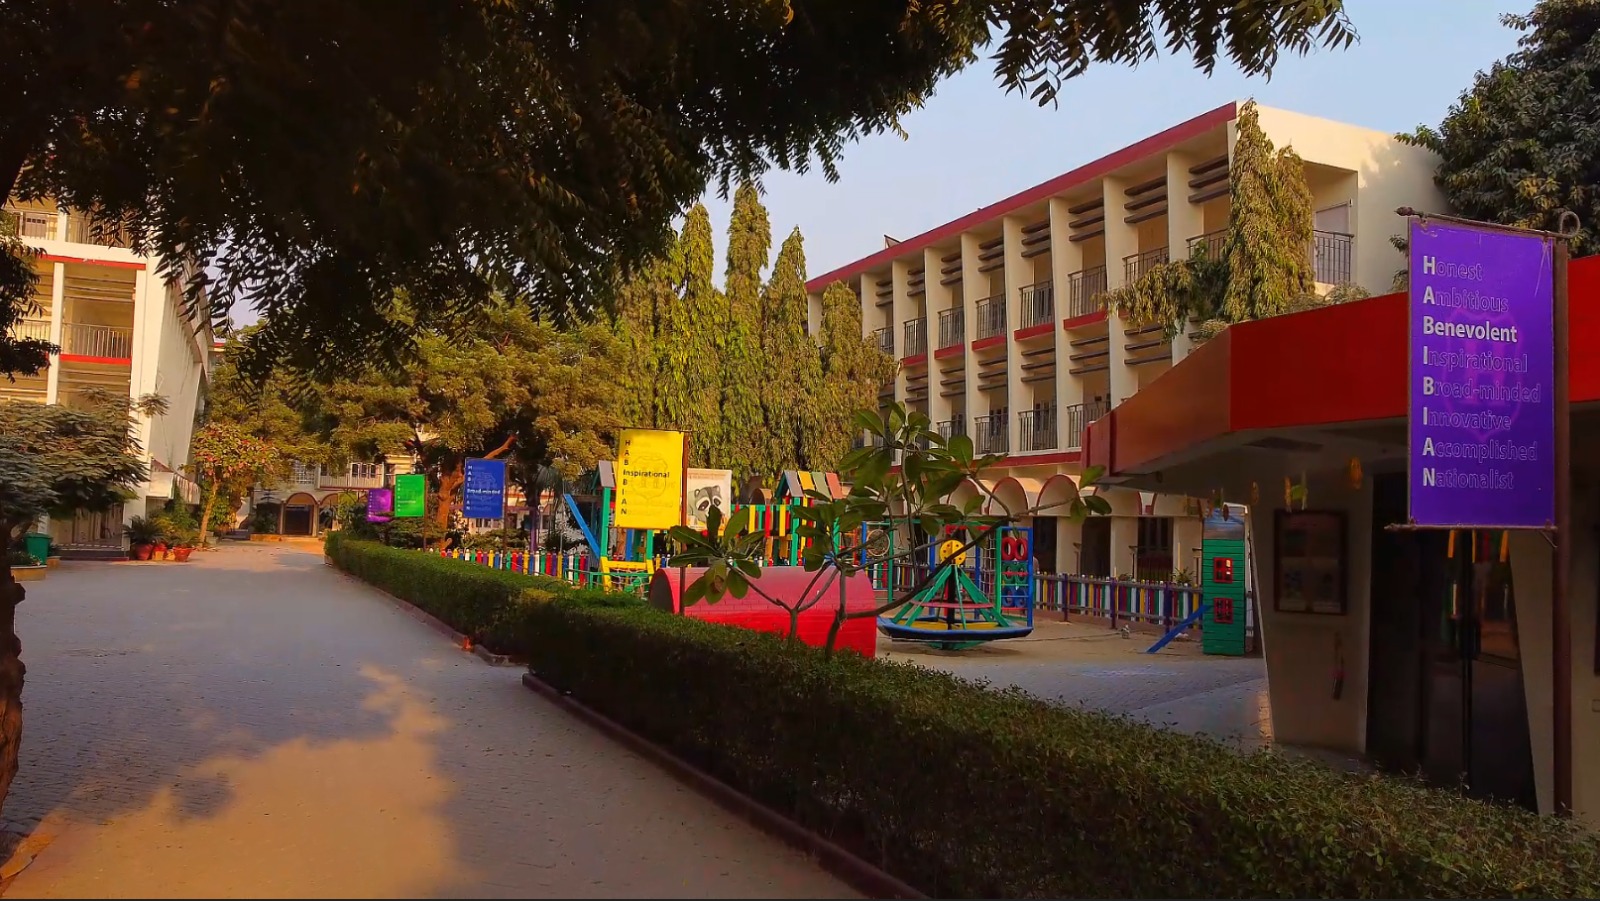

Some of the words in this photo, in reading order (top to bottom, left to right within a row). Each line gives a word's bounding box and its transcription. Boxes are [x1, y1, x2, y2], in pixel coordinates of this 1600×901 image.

[1422, 254, 1483, 282] Honest
[1422, 284, 1509, 313] Ambitious
[1422, 314, 1518, 343] Benevolent
[1422, 345, 1528, 373] Inspirational
[1422, 375, 1542, 404] Broad-minded
[1422, 406, 1512, 430] Innovative
[1422, 436, 1538, 464] Accomplished
[622, 468, 670, 479] Inspirational
[1422, 467, 1514, 490] Nationalist
